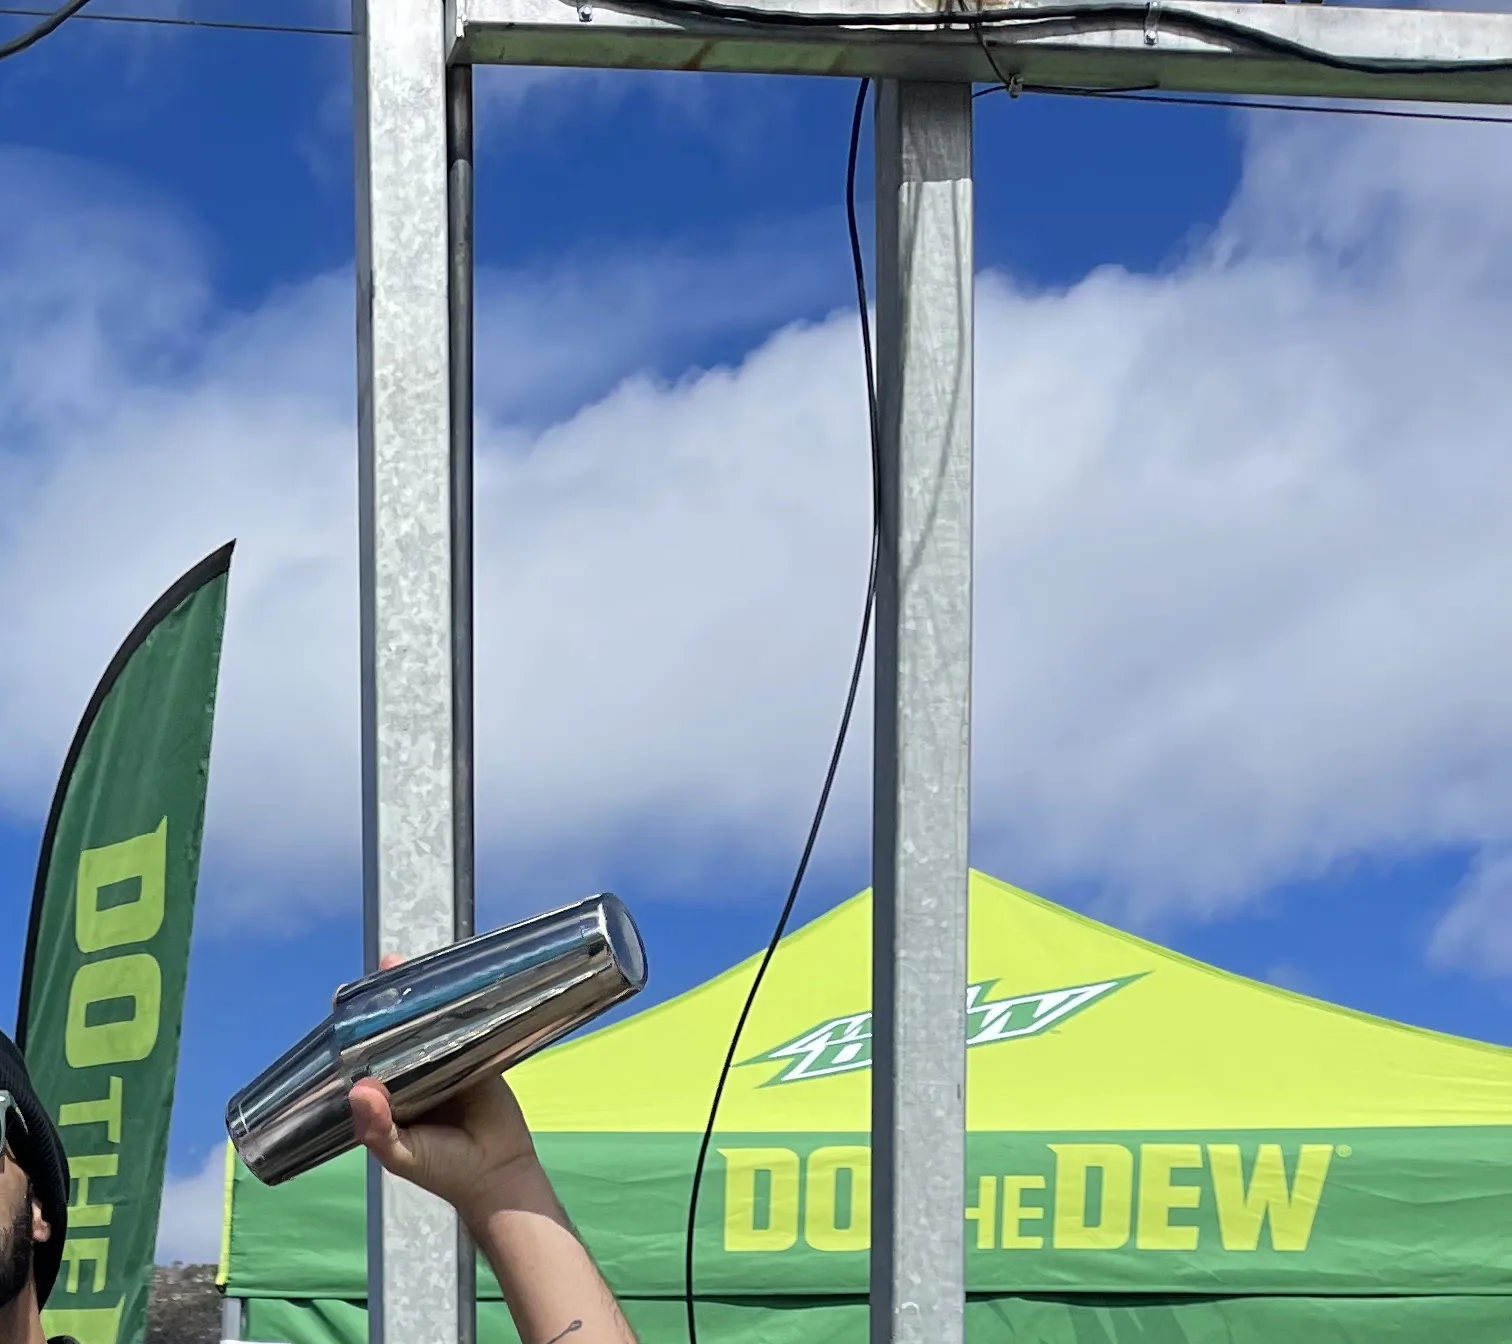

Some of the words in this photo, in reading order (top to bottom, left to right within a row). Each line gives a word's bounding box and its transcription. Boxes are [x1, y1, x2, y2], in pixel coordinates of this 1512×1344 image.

[64, 815, 168, 1069] DO
[716, 1144, 872, 1252] DO
[964, 1175, 1046, 1250] HE
